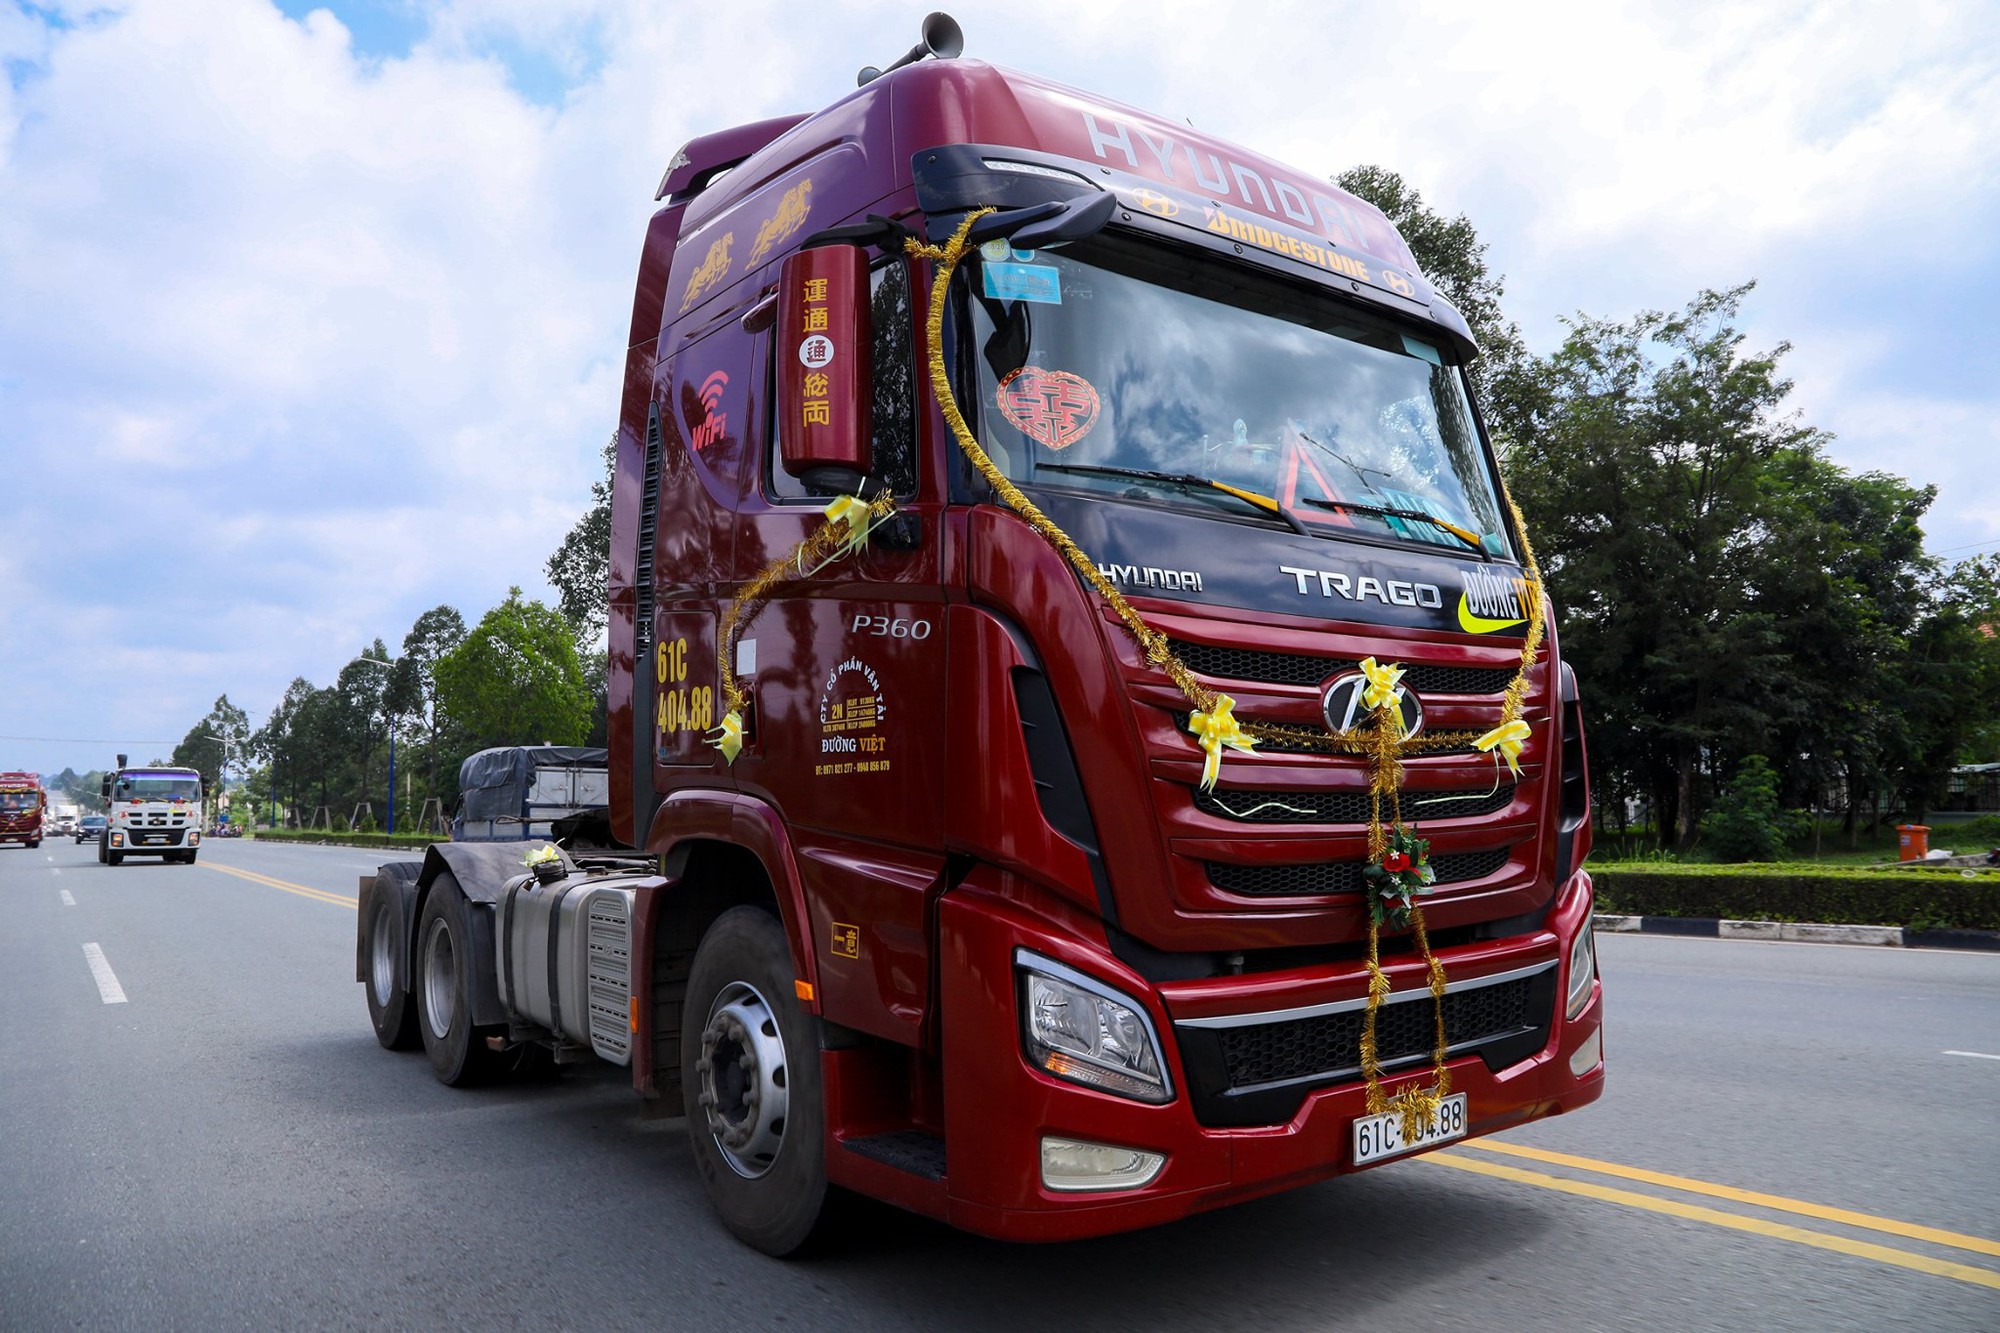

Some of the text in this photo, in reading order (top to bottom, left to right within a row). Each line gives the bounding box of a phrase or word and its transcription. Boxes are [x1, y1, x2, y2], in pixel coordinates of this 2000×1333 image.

[1081, 111, 1369, 250] HYUNDAI
[1203, 206, 1370, 282] BRIDGESTONE
[1098, 562, 1203, 592] HYUNDAI
[1279, 565, 1443, 609] TRAGO
[1460, 563, 1520, 620] ĐƯỜNG
[851, 614, 932, 640] P360
[657, 637, 688, 684] 61C
[657, 685, 712, 734] 404.88
[831, 703, 843, 720] 2N
[821, 734, 886, 754] ĐƯỜNG VIỆT
[1359, 1100, 1462, 1157] 61C-04.88
